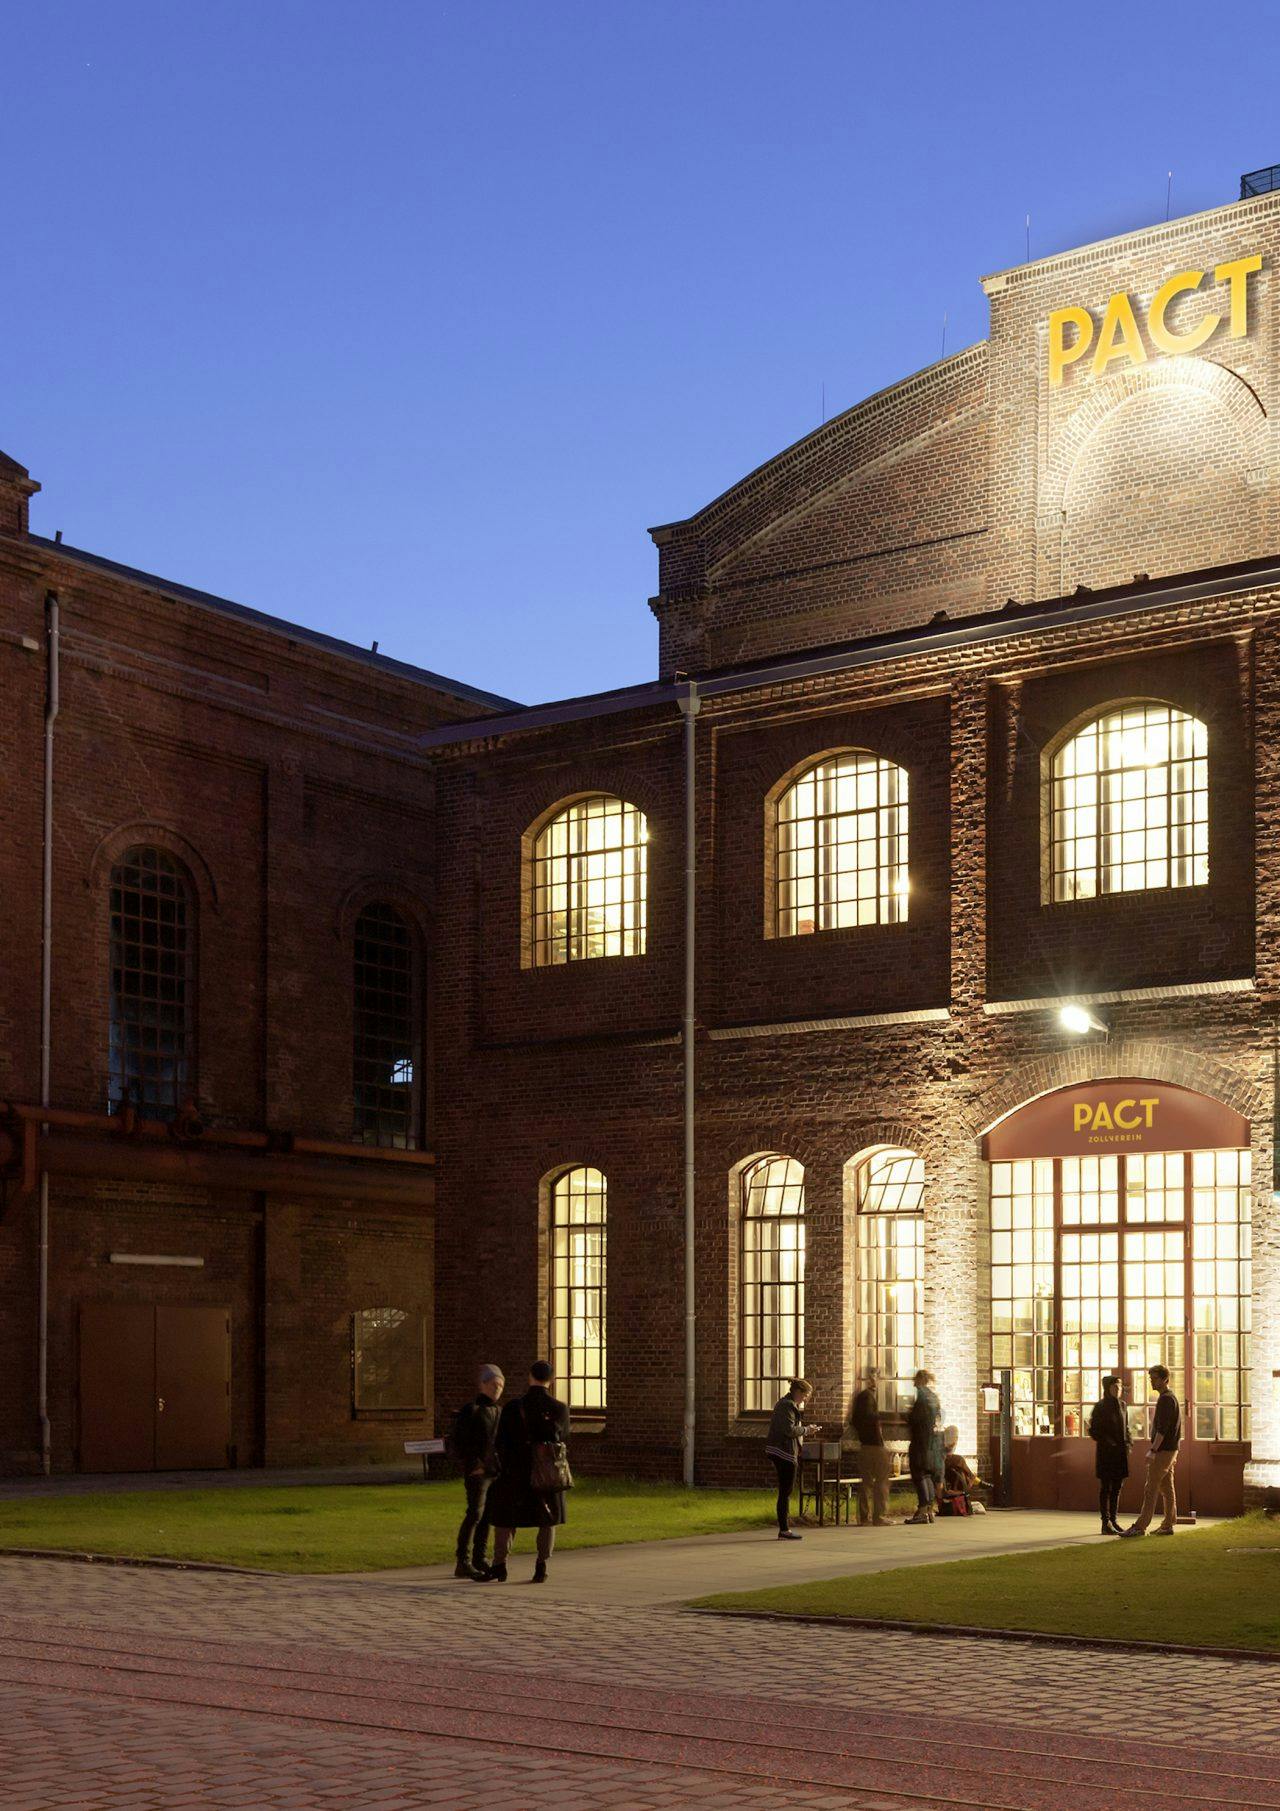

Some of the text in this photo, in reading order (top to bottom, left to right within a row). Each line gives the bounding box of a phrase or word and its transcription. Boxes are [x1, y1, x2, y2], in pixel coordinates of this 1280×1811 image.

[1048, 252, 1263, 387] PACT
[1073, 1098, 1160, 1132] PACT
[1088, 1133, 1142, 1144] ZOLLVEREIN
